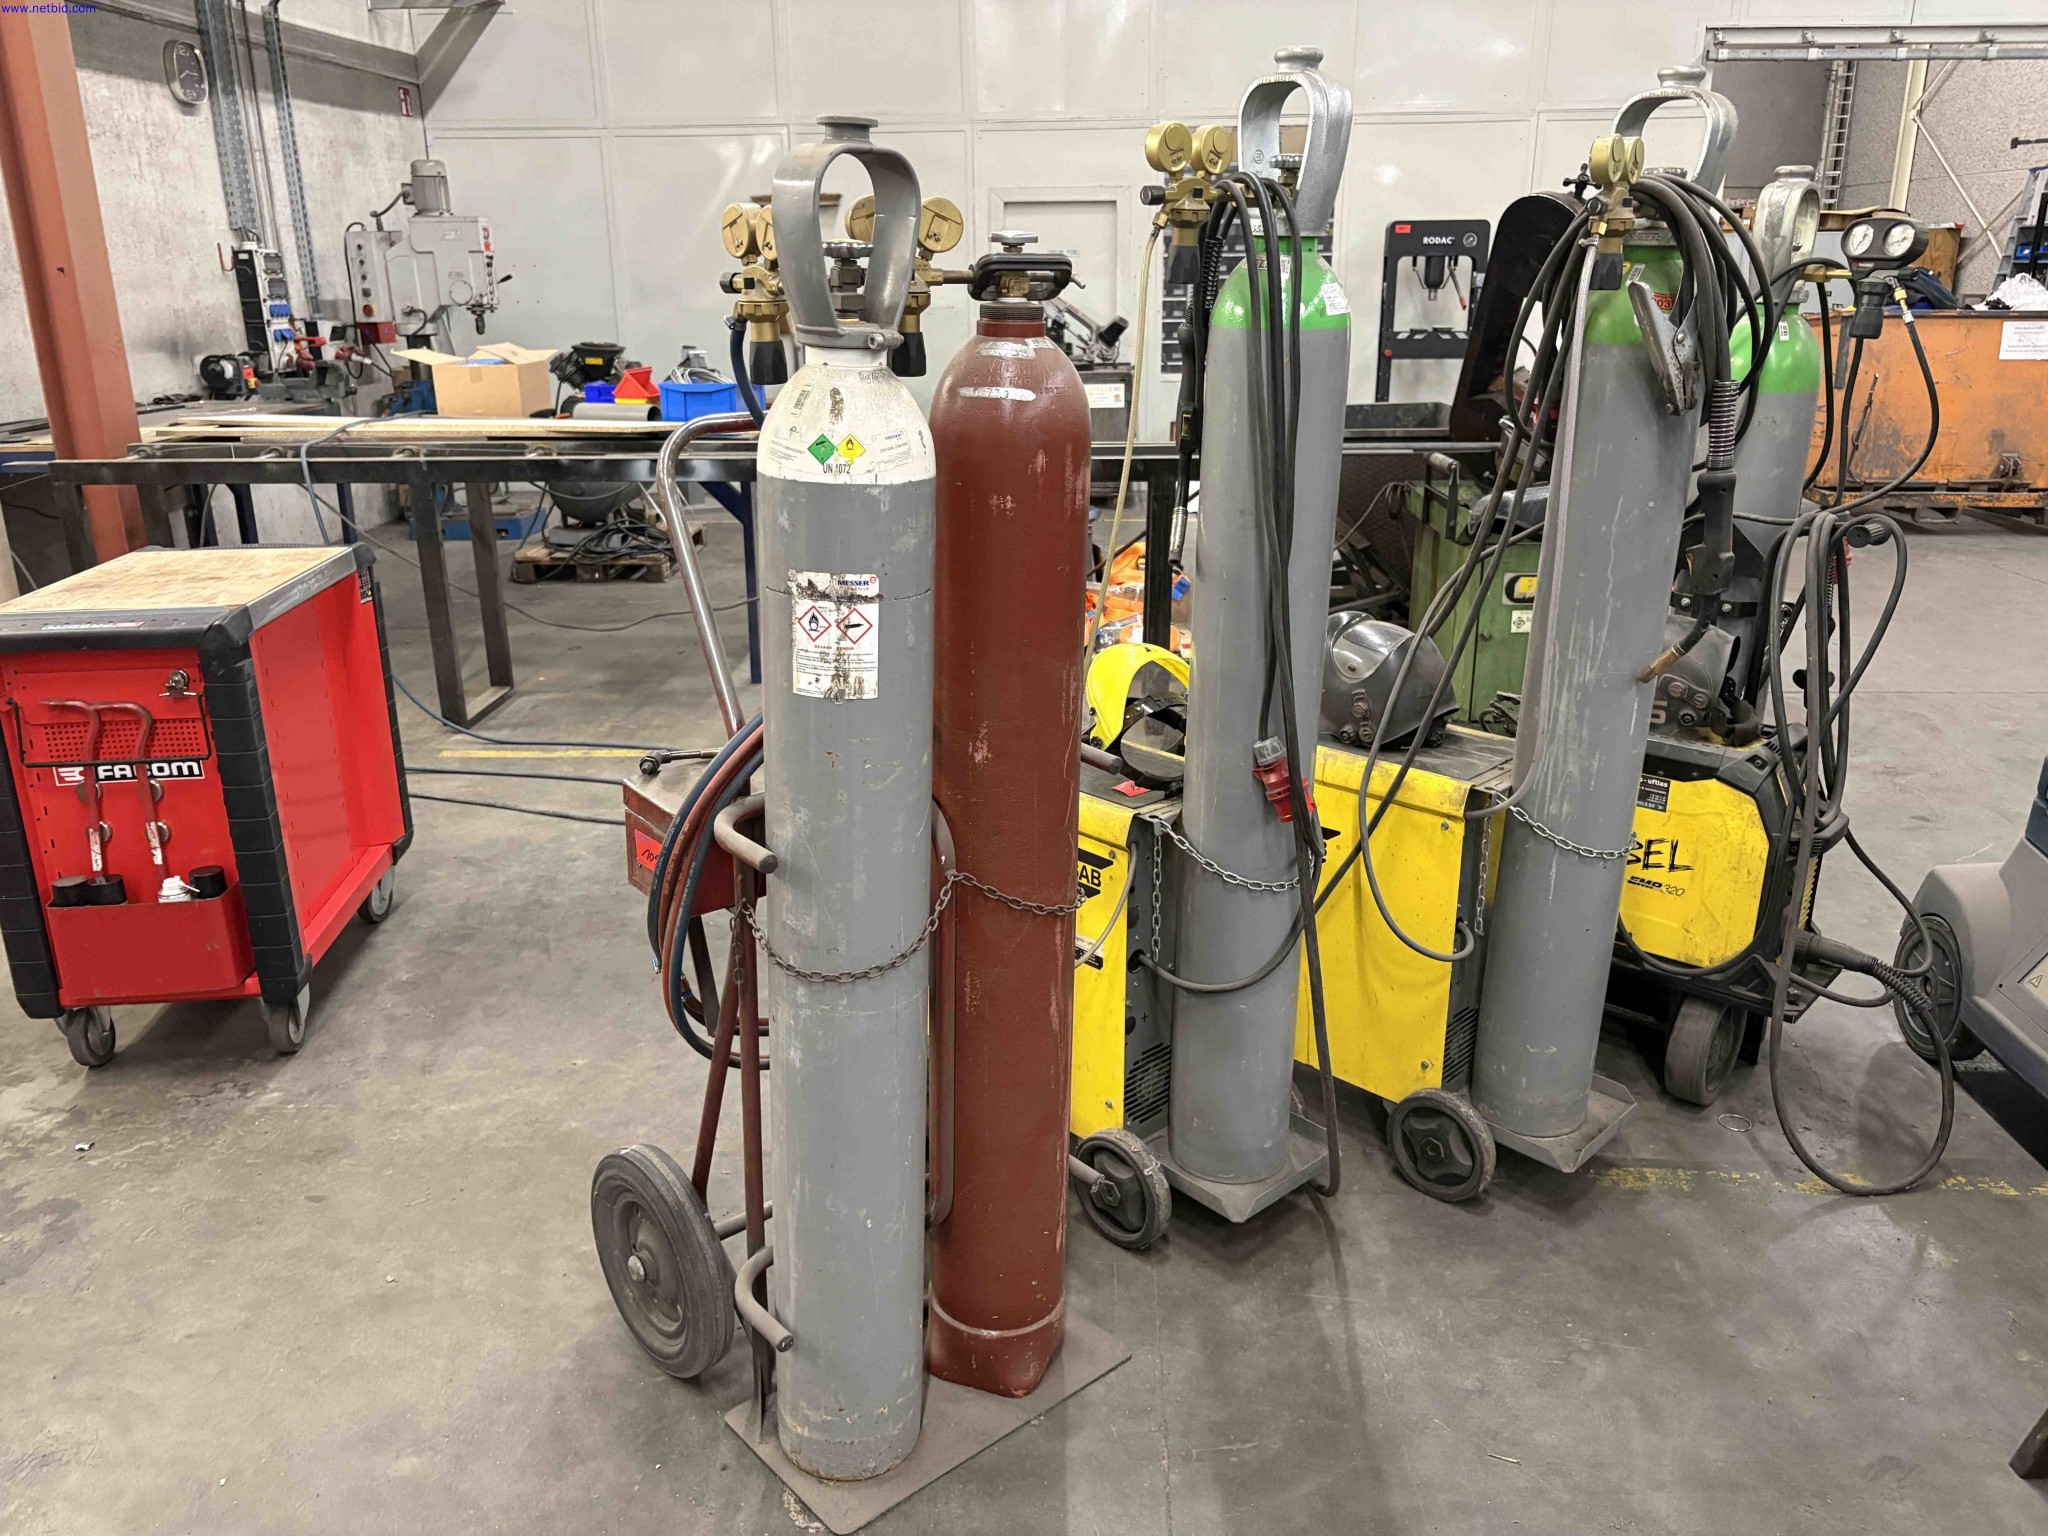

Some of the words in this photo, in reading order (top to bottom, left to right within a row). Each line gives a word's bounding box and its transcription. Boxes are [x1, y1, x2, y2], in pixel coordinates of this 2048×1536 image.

[1422, 236, 1453, 245] RODAC
[822, 463, 833, 474] UN
[1077, 864, 1102, 888] AB
